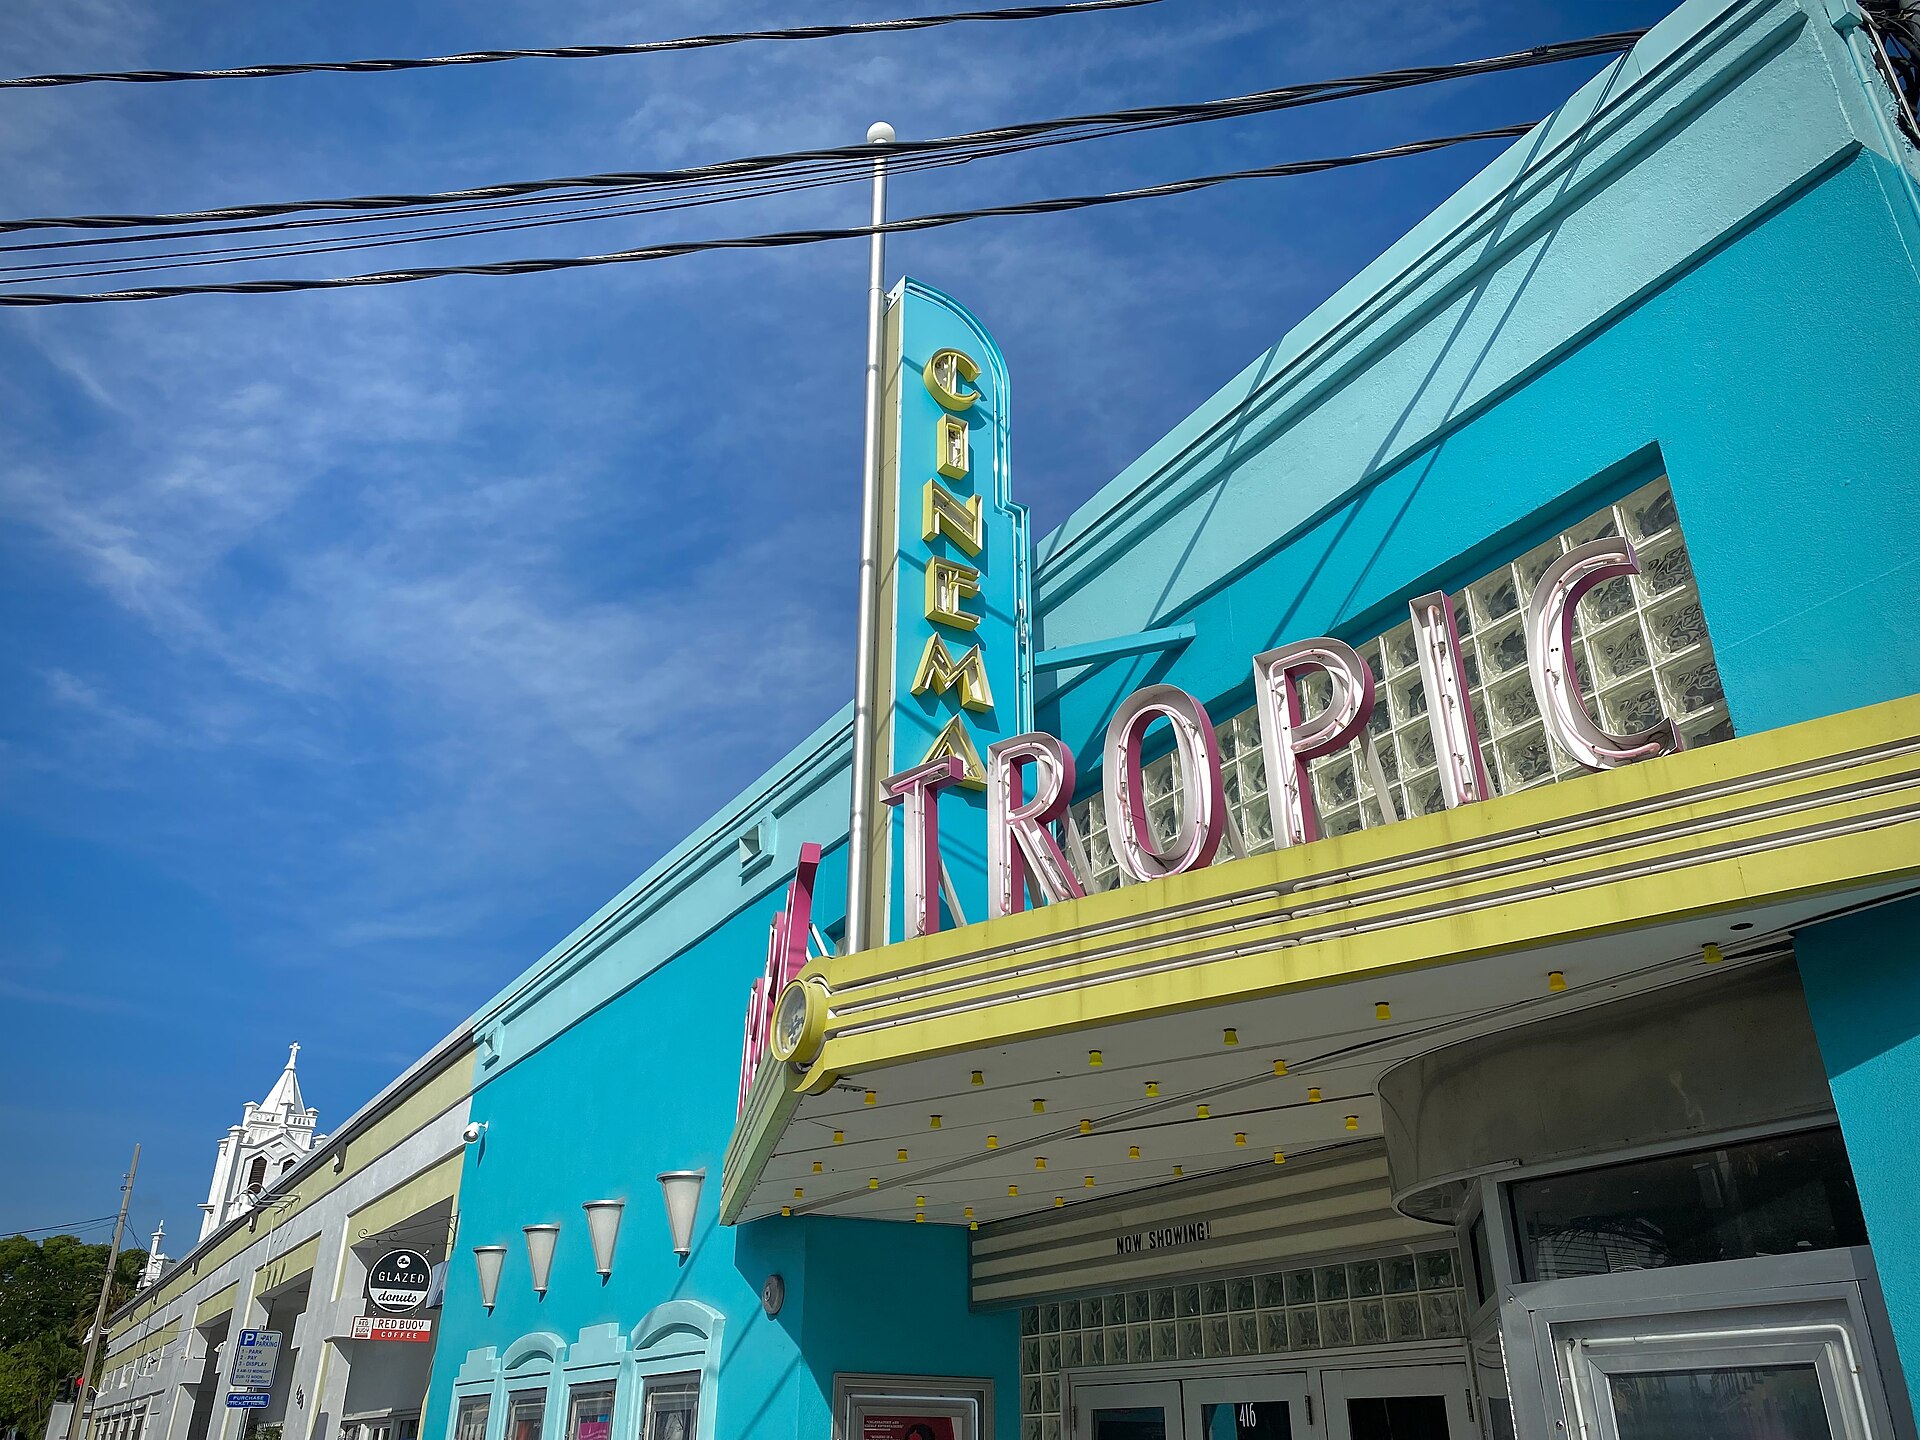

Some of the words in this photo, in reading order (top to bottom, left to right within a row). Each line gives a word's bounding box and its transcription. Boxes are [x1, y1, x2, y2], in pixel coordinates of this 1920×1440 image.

[910, 347, 994, 791] CINEMA
[880, 536, 1683, 939] TROPIC
[1116, 1233, 1142, 1255] NOW
[1148, 1220, 1212, 1250] SHOWING!
[378, 1271, 424, 1284] GLAZED
[378, 1290, 417, 1303] donuts
[377, 1319, 397, 1329] RED
[399, 1320, 425, 1330] BUOY
[243, 1333, 255, 1346] P
[381, 1331, 418, 1339] COFFEE
[1239, 1403, 1257, 1428] 416
